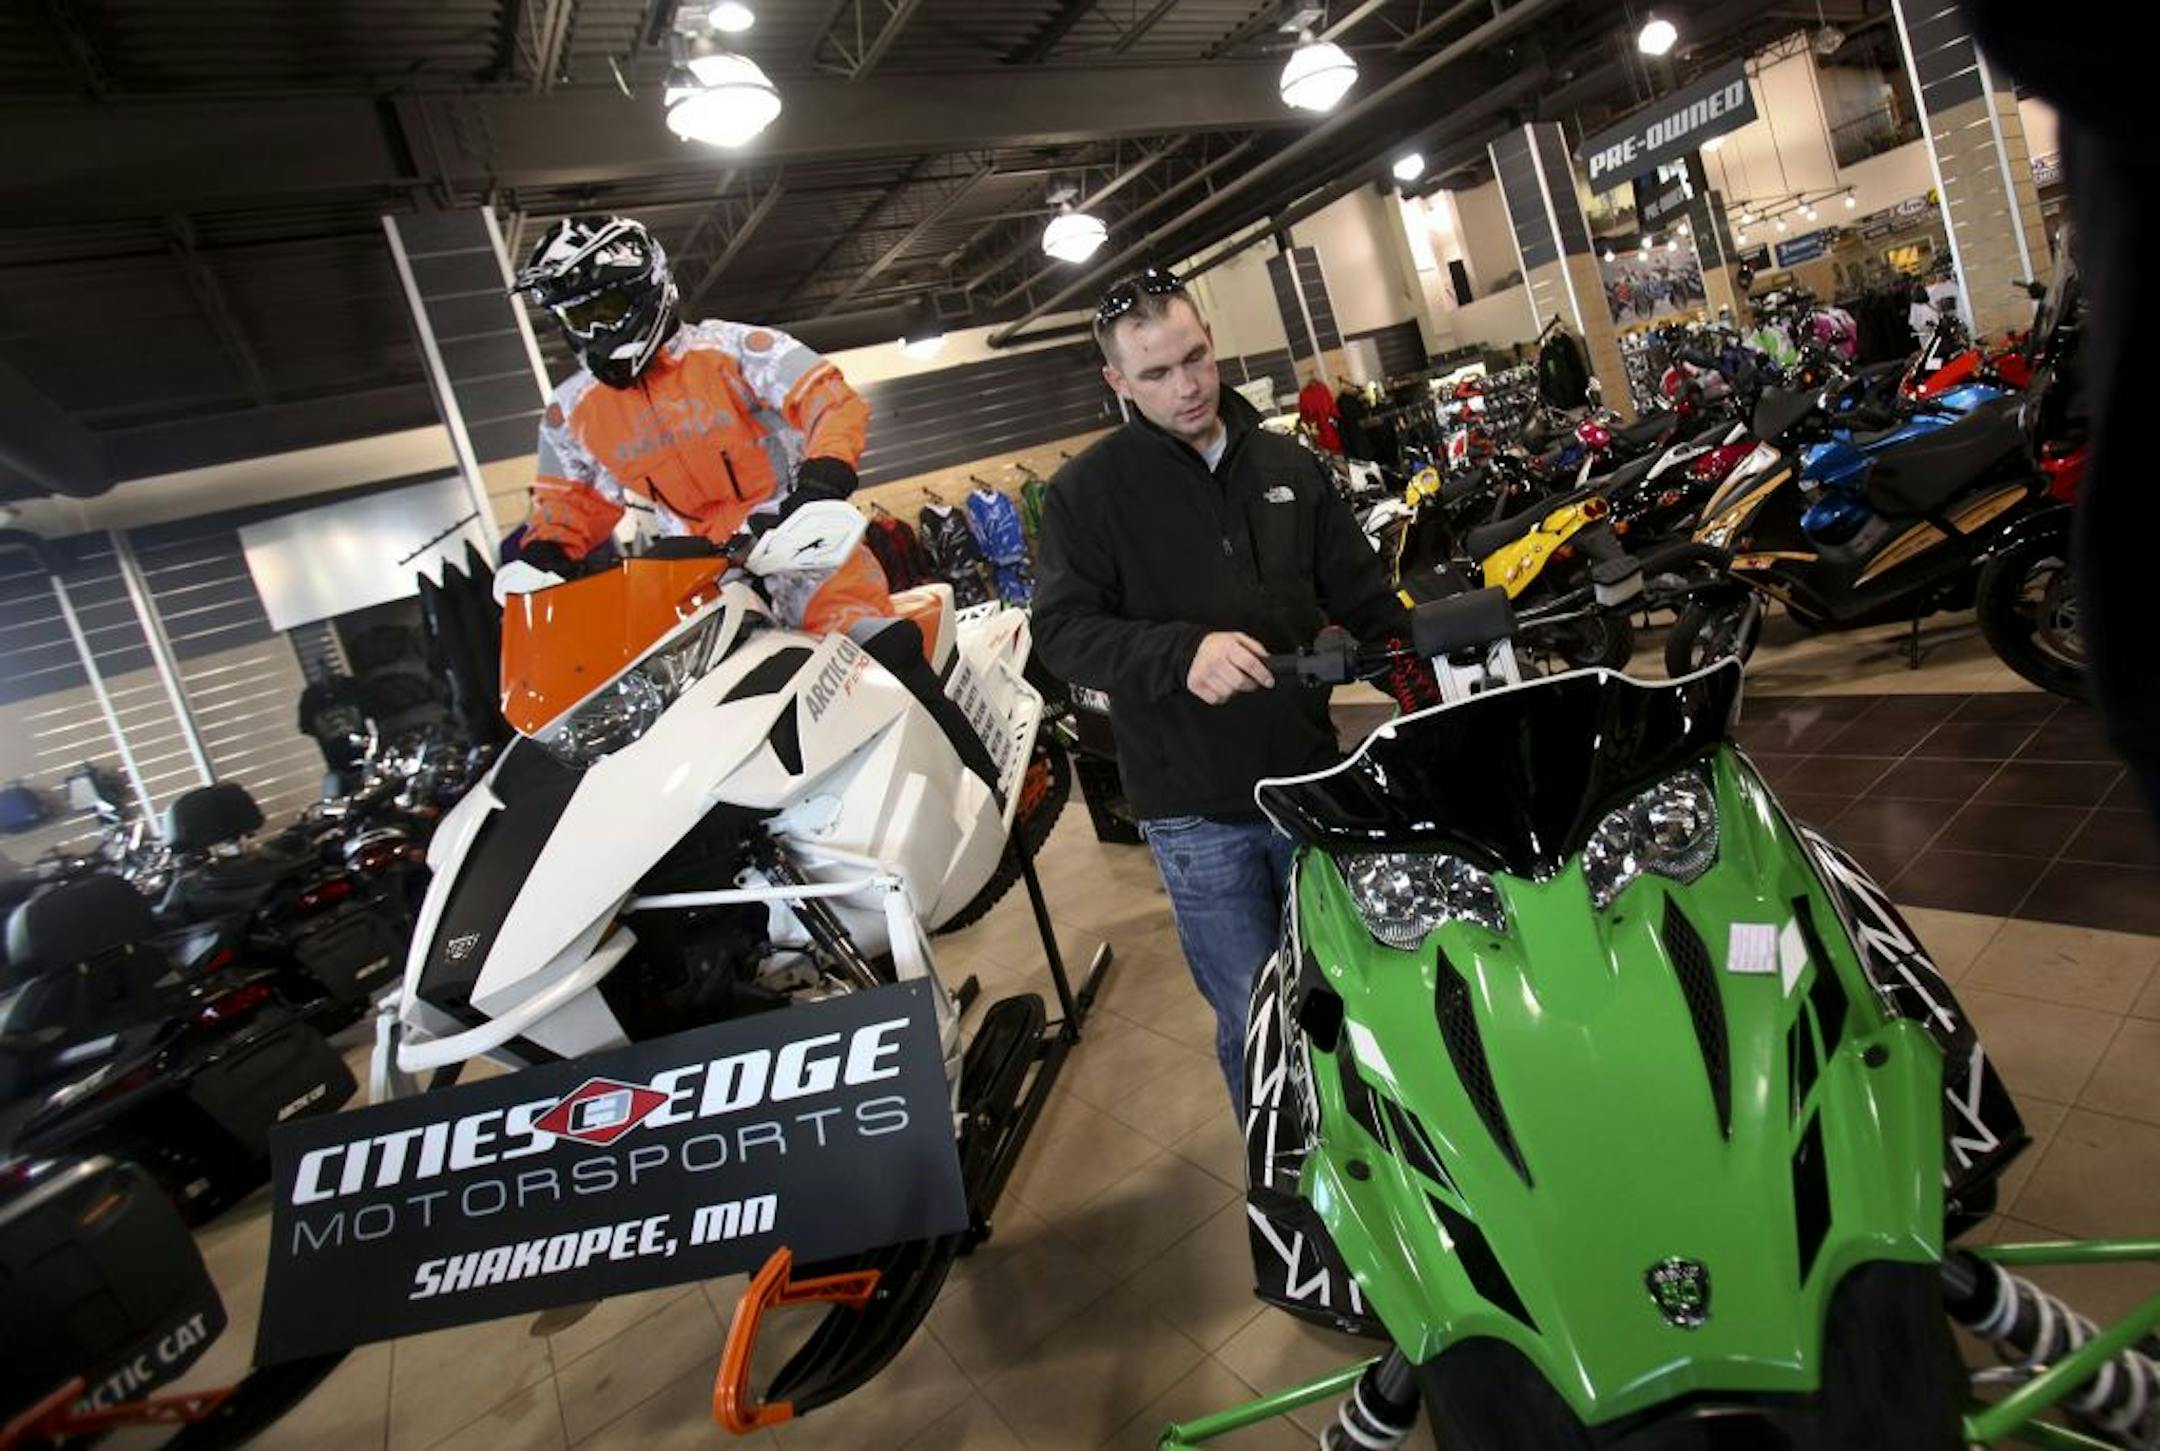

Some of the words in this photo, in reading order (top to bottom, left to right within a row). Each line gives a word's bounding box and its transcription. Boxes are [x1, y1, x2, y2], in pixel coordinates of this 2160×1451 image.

[1589, 79, 1744, 178] PRE-OWNED
[805, 656, 848, 723] ARCTIC
[291, 1097, 560, 1206] CITIES
[643, 1017, 911, 1130] EDGE
[292, 1095, 911, 1255] MOTORSPORTS
[408, 1214, 678, 1301] SHAKOPEE,
[690, 1194, 779, 1245] MN
[157, 1313, 207, 1364] CAT
